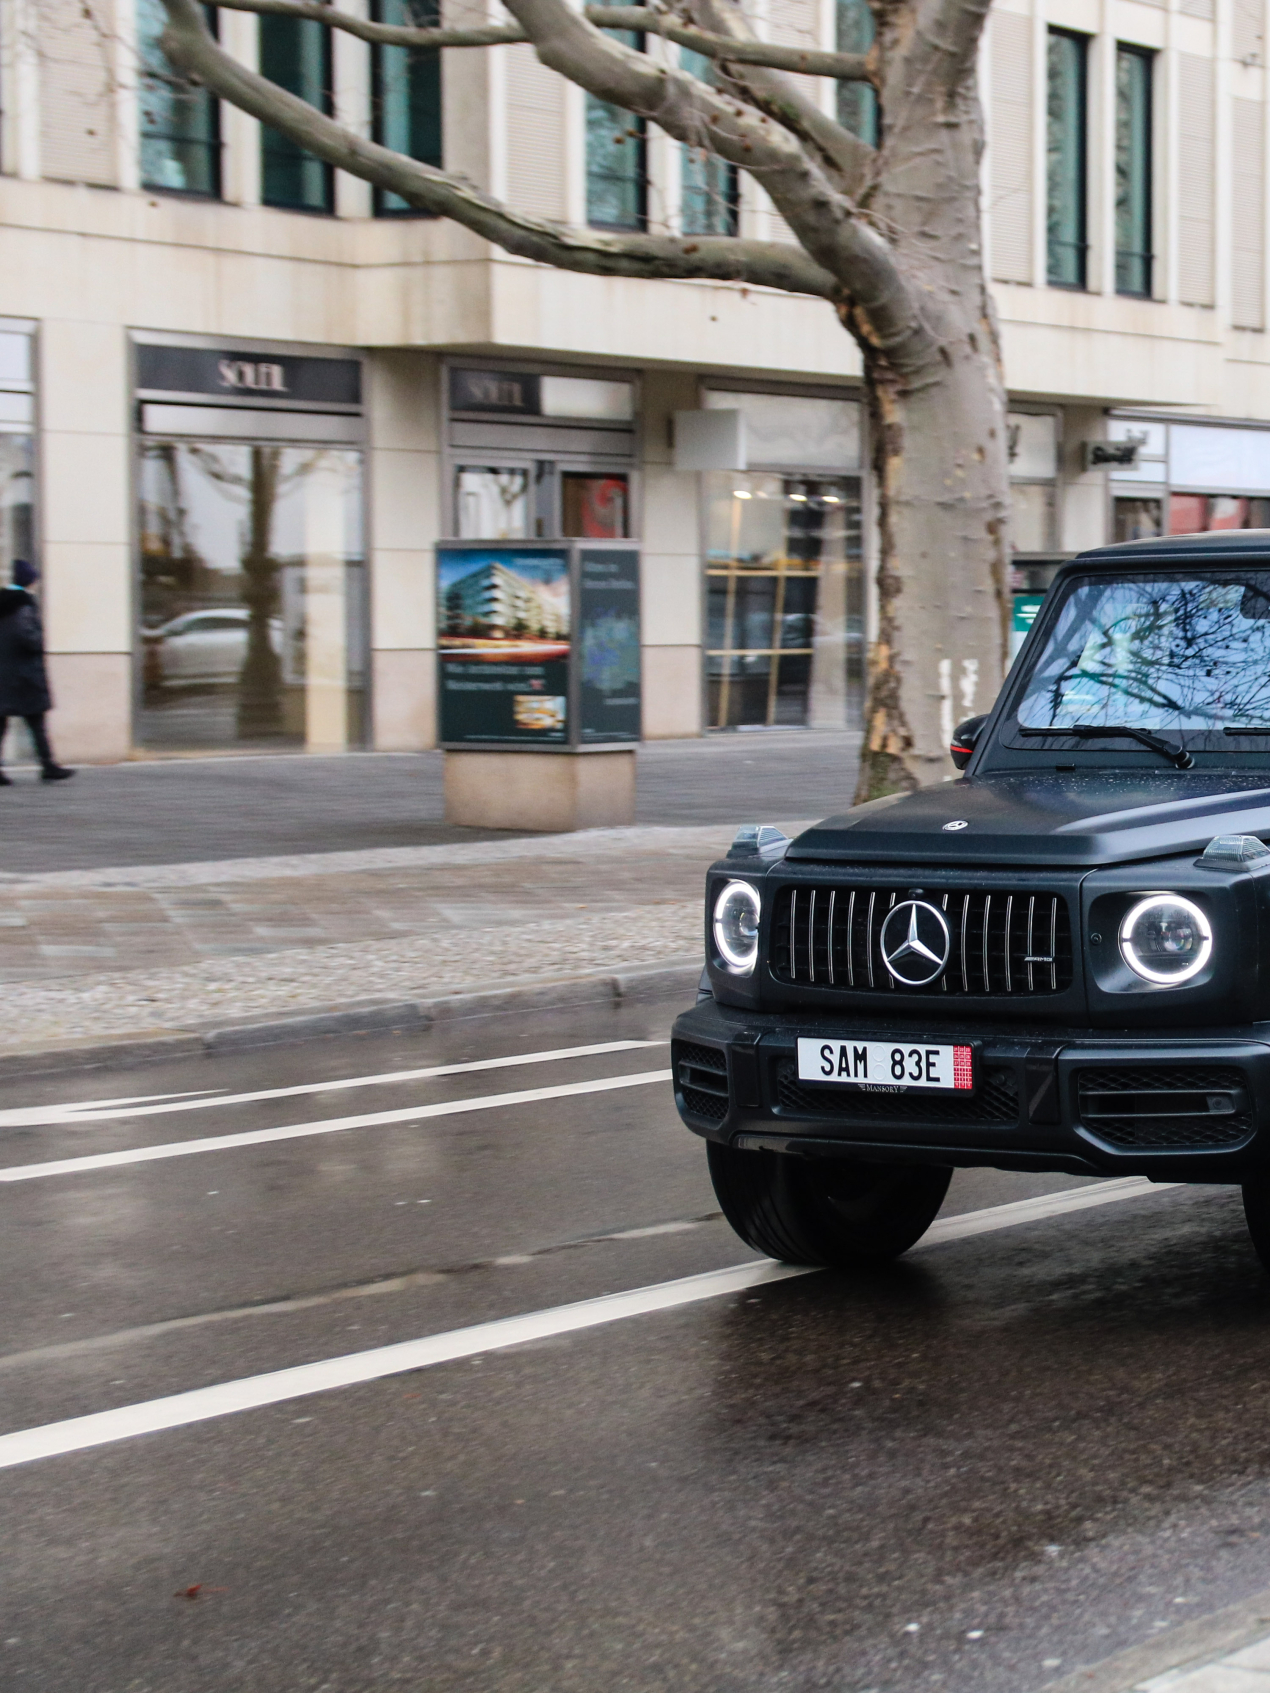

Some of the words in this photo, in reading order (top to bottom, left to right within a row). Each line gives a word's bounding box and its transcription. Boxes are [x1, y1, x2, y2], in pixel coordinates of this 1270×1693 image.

[820, 1044, 868, 1079] SAM
[890, 1048, 941, 1082] 83E
[866, 1083, 899, 1093] MANSORY
